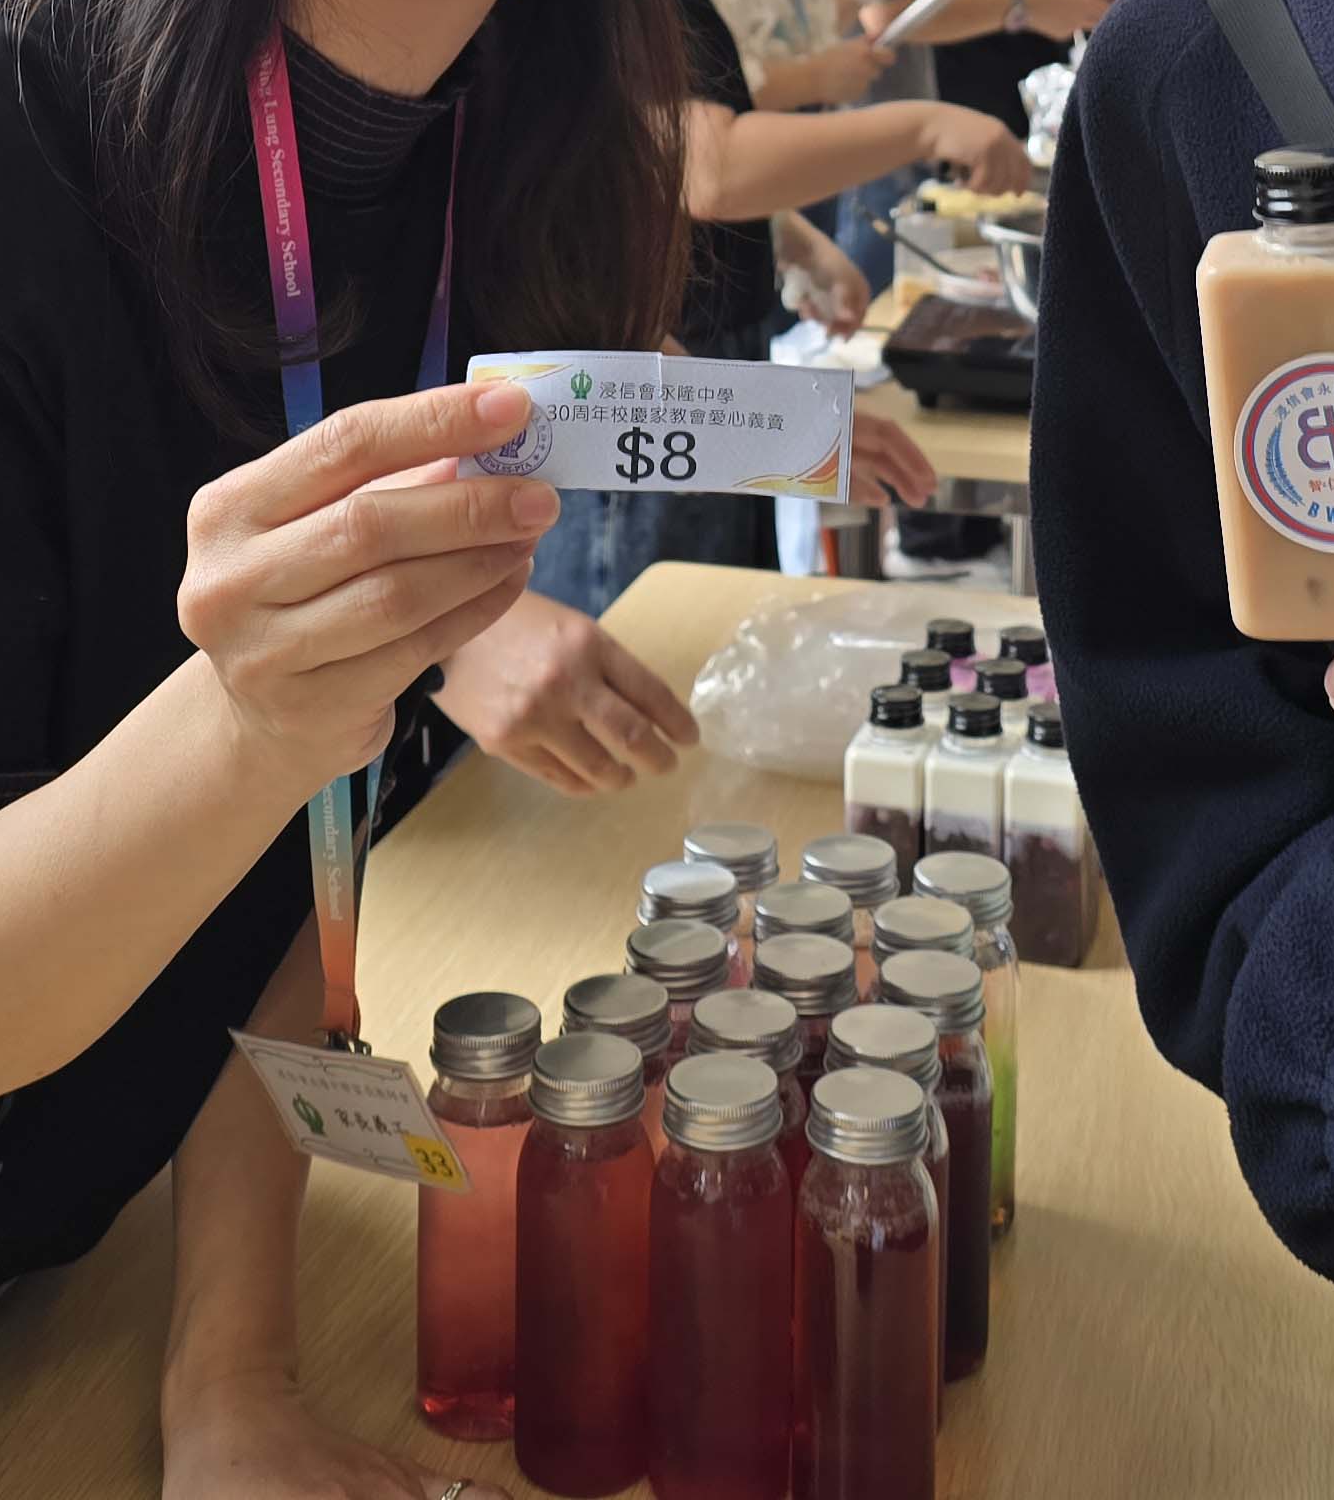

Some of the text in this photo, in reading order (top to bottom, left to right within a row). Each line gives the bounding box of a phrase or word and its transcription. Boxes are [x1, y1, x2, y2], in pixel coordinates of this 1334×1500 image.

[269, 148, 293, 239] Secondary
[281, 239, 301, 299] School
[614, 426, 698, 484] $8
[326, 866, 344, 922] School
[414, 1148, 454, 1178] 33
